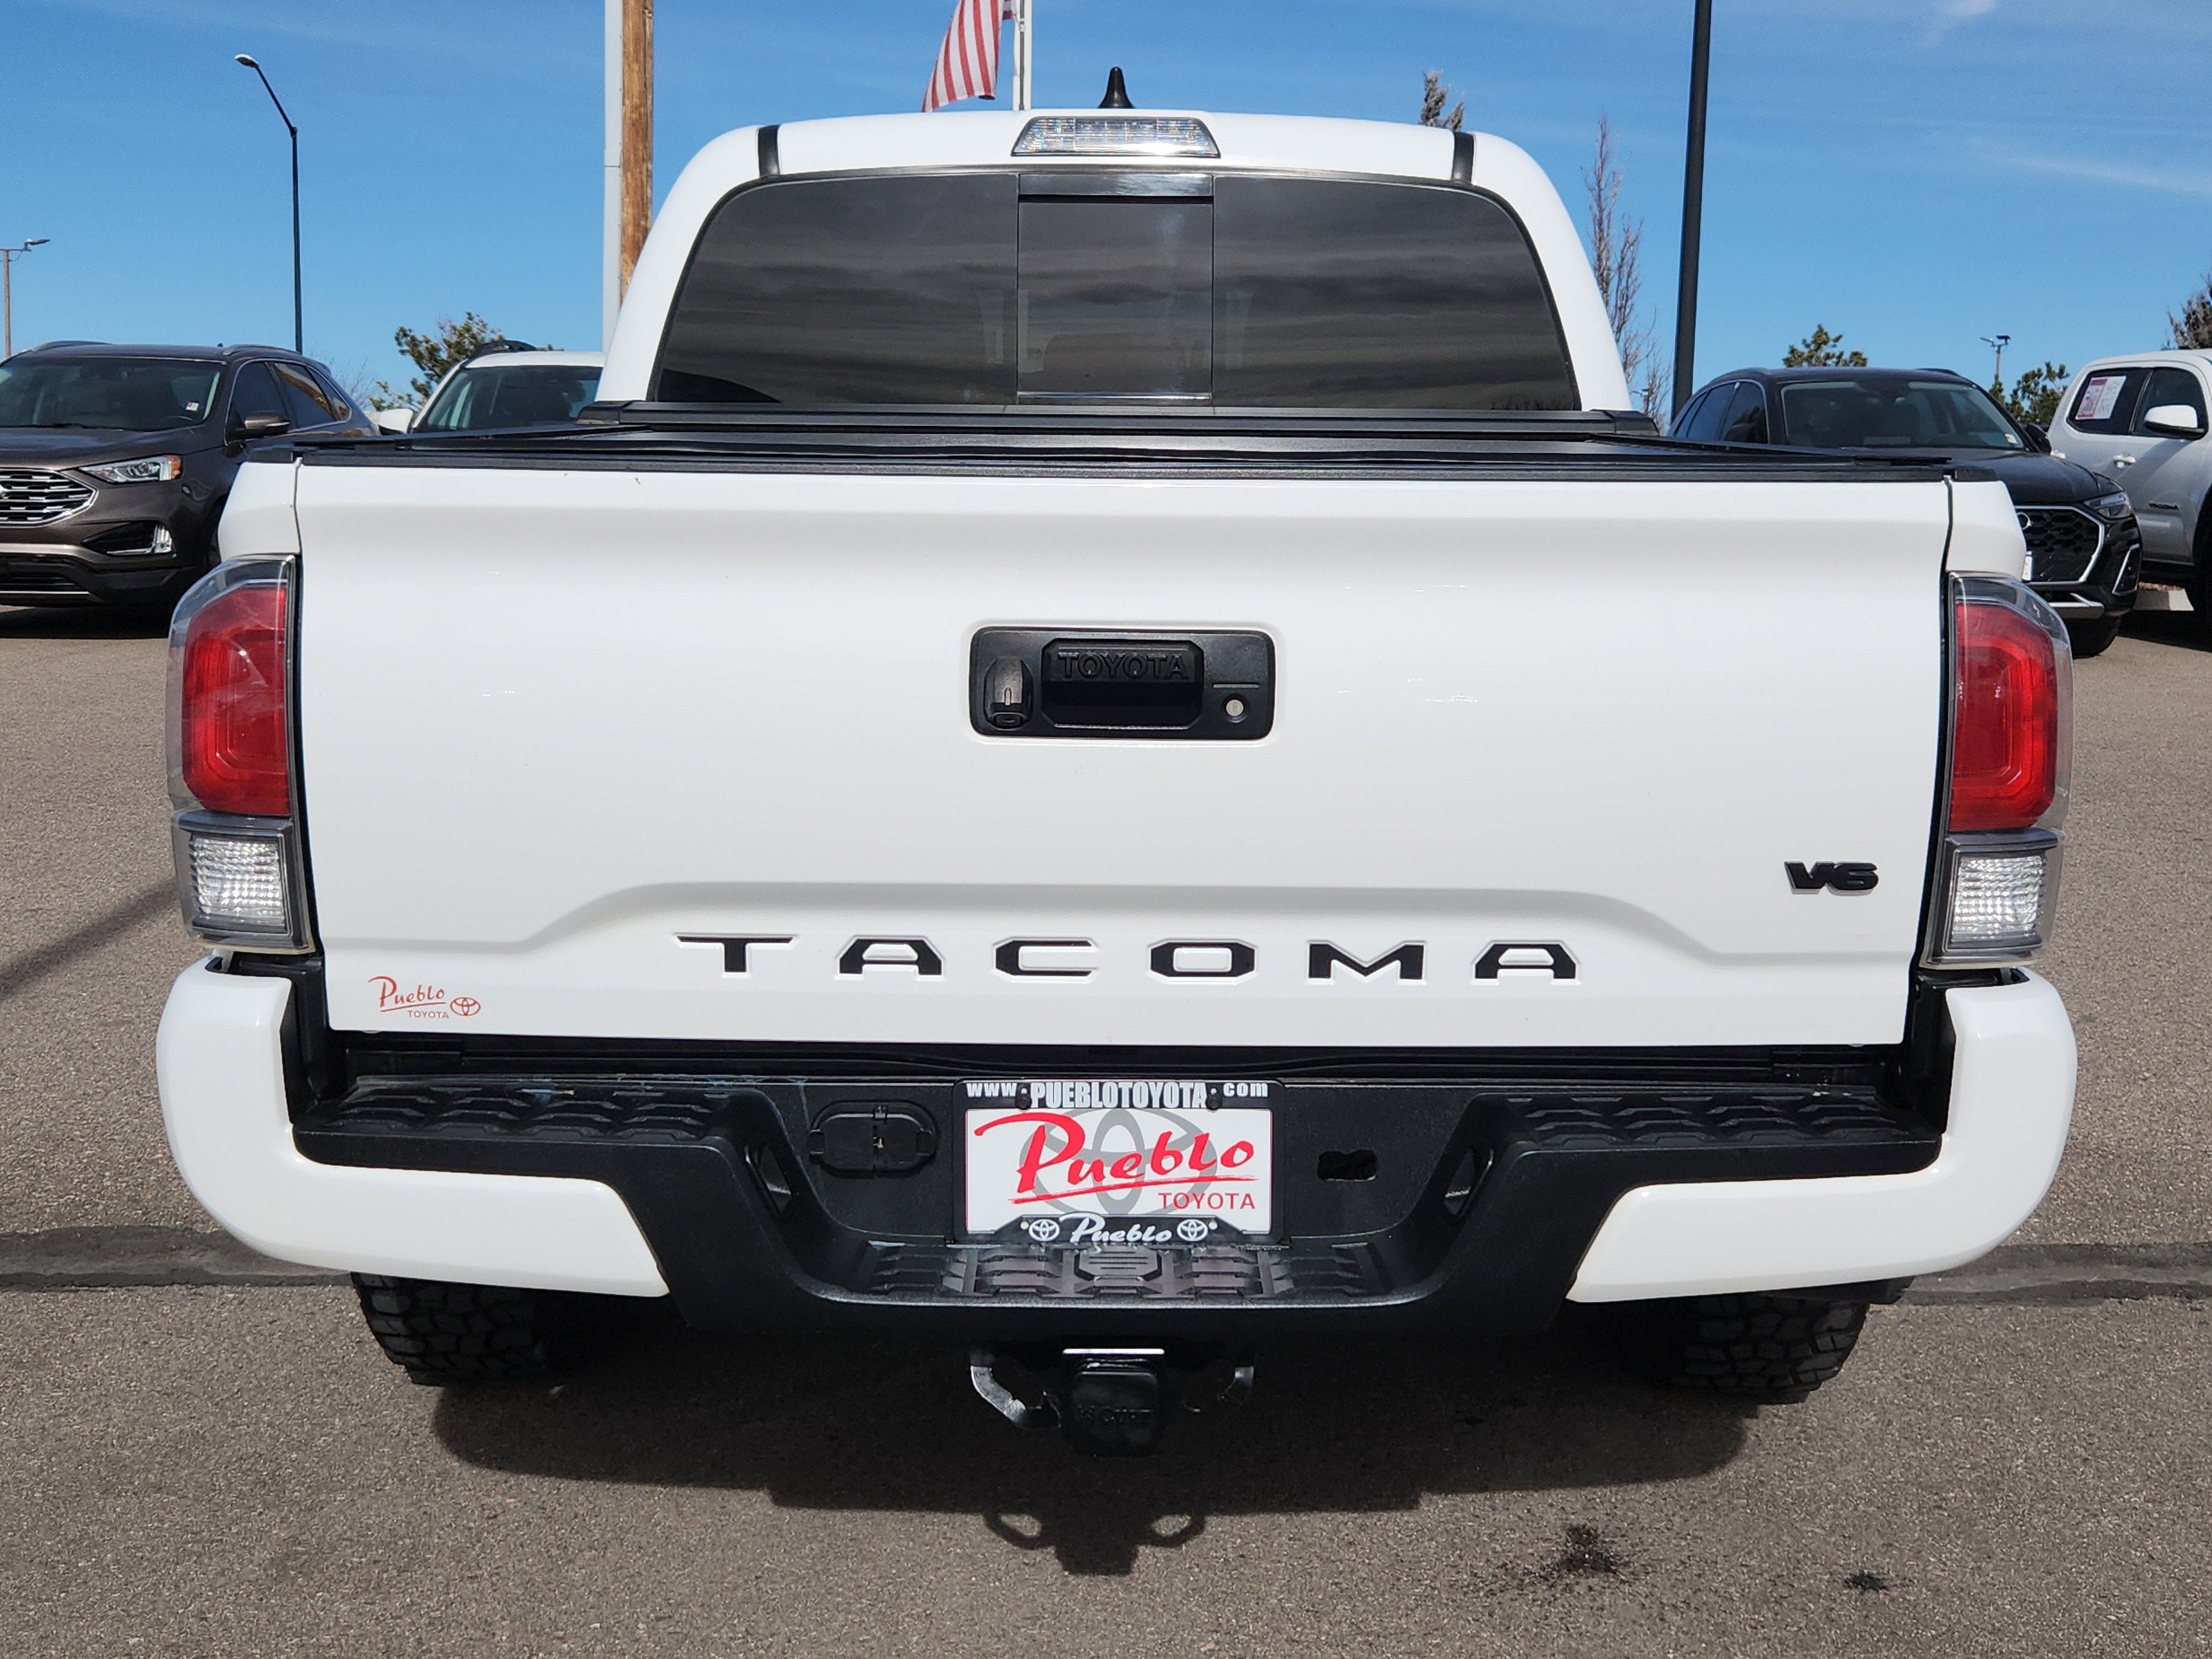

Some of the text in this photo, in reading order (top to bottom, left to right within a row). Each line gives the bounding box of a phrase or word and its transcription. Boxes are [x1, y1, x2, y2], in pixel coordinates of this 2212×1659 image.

[1058, 652, 1189, 680] TOYOTA
[1784, 861, 1879, 891] V6
[676, 935, 1581, 981] TACOMA
[368, 976, 446, 1007] Pueblo
[408, 1010, 449, 1019] TOYOTA
[974, 1112, 1254, 1193] Pueblo
[1158, 1192, 1256, 1210] TOYOTA
[1059, 1212, 1172, 1242] Pueblo
